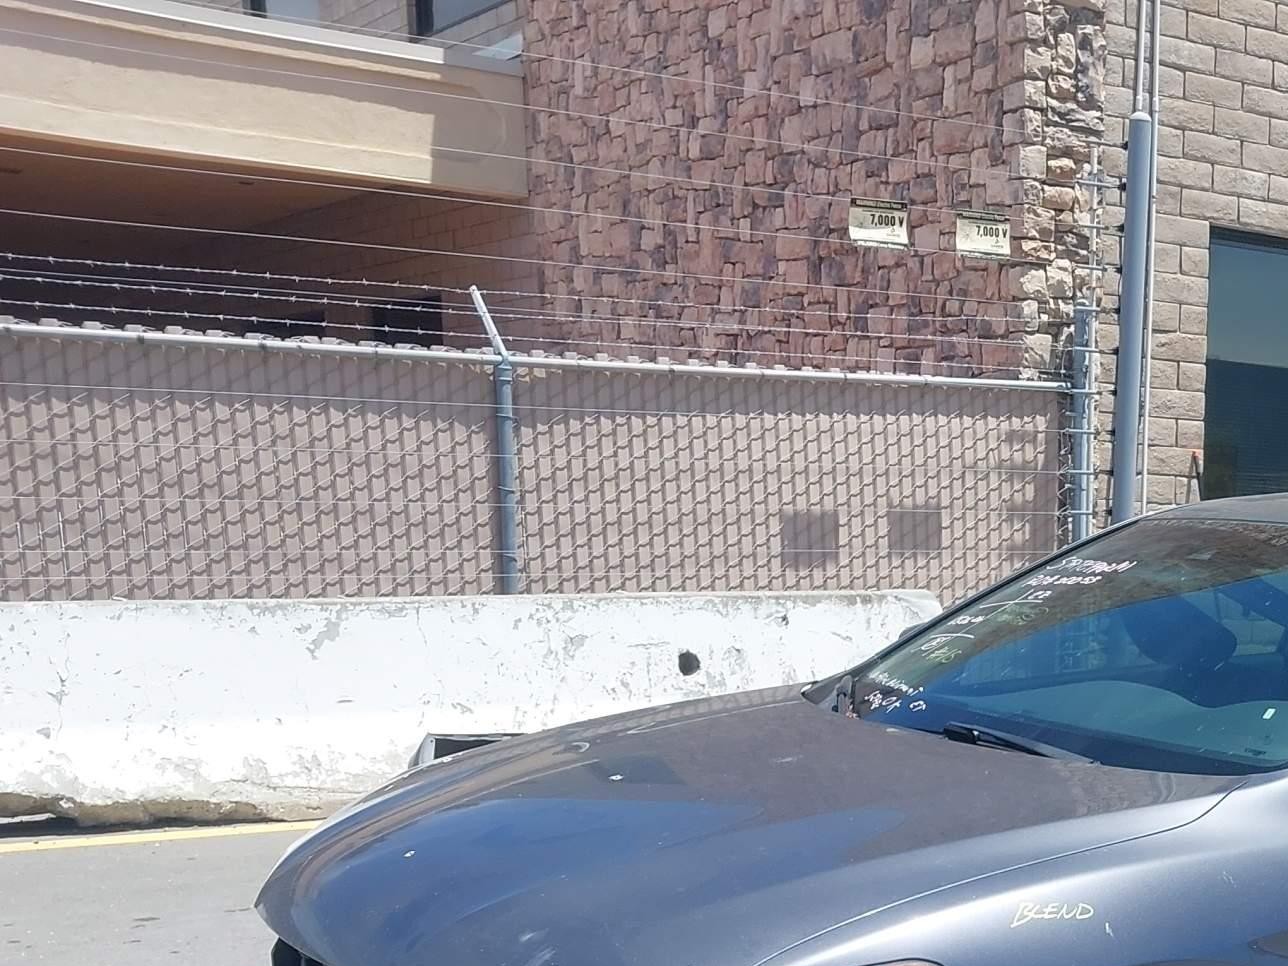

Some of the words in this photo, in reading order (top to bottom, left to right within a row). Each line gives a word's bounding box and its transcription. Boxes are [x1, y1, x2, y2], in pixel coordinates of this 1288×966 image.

[870, 214, 896, 227] 7,000
[898, 216, 904, 227] V
[976, 225, 1000, 238] 7,000
[1002, 228, 1008, 238] V
[1009, 902, 1095, 928] BLEND
